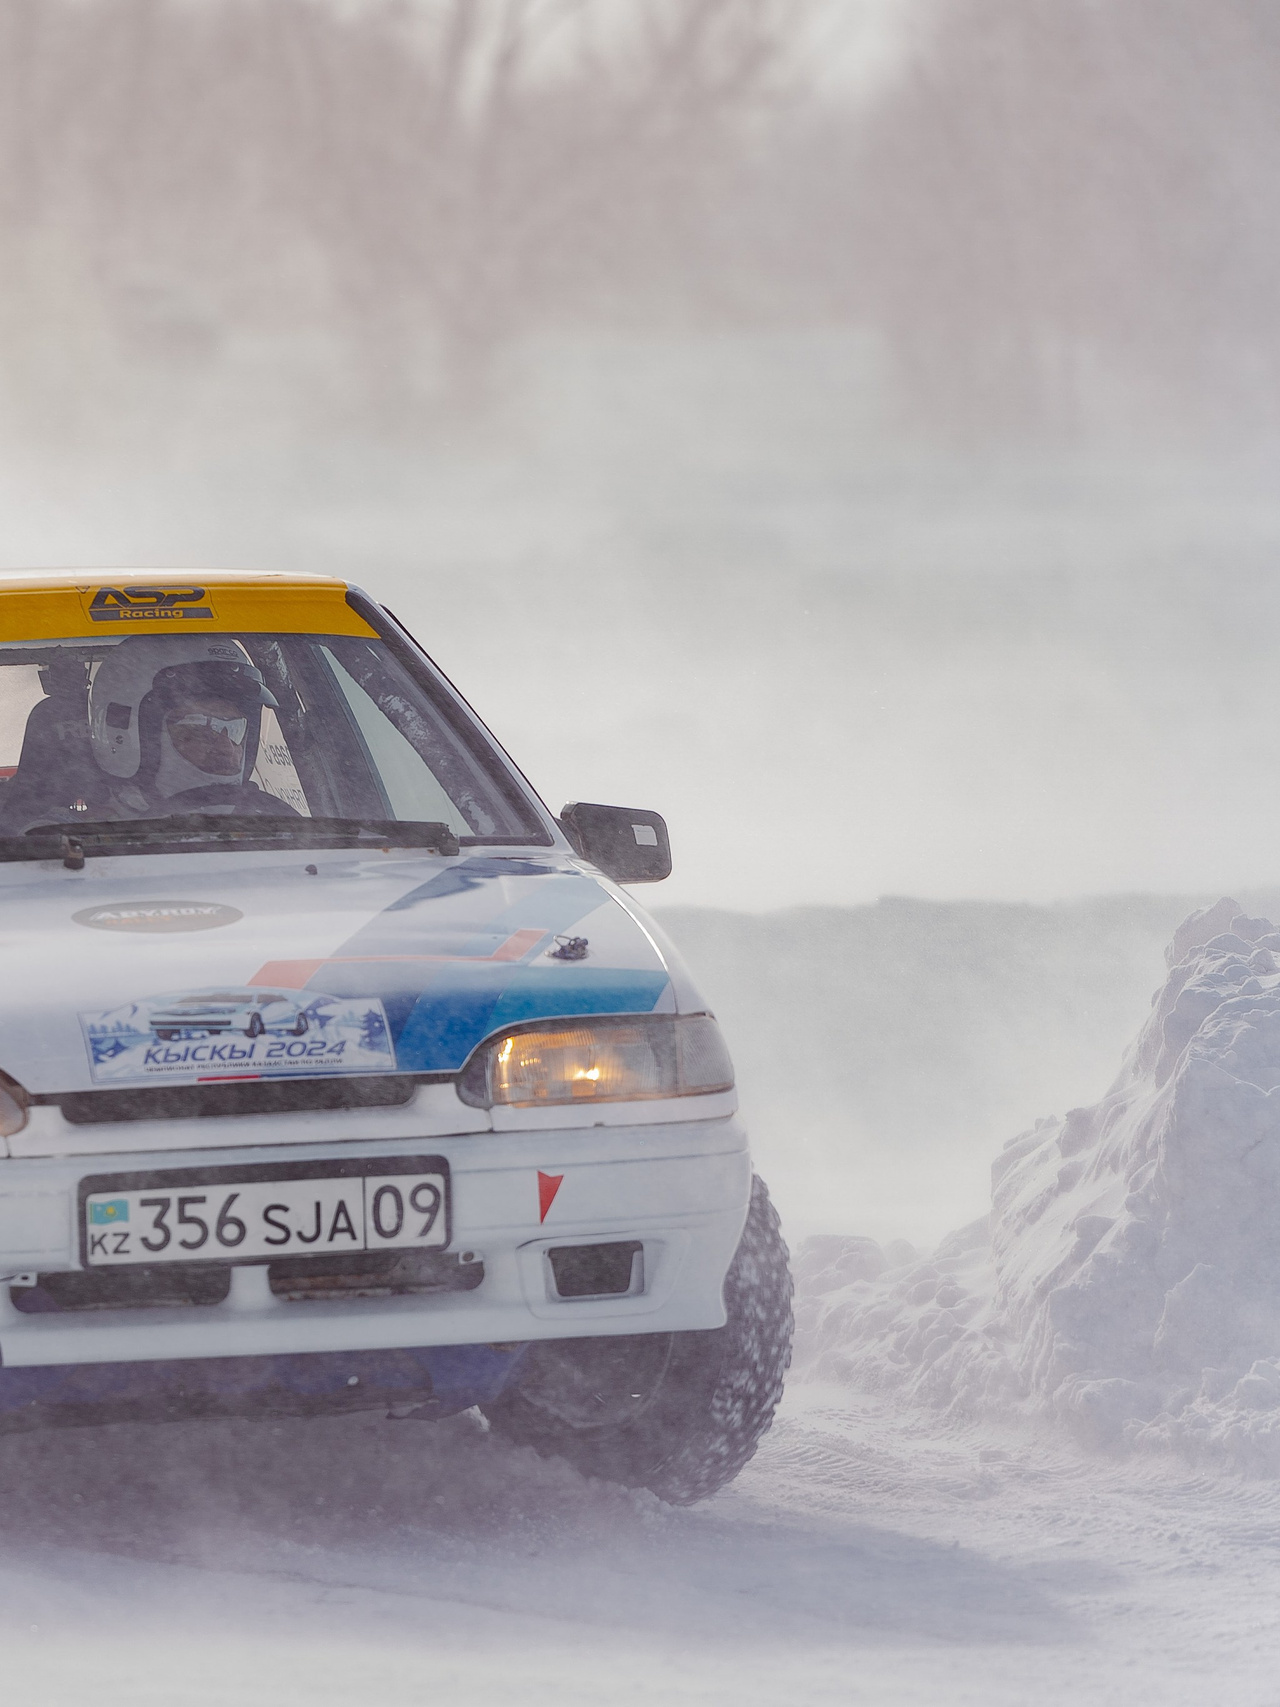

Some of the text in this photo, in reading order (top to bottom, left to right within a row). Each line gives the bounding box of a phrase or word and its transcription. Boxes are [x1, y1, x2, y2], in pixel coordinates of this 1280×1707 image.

[89, 585, 206, 609] ASP
[120, 608, 184, 619] Racing
[143, 1040, 347, 1065] КЫСКЫ 2024
[140, 1182, 441, 1252] 356 SJA 09
[90, 1233, 131, 1256] KZ
